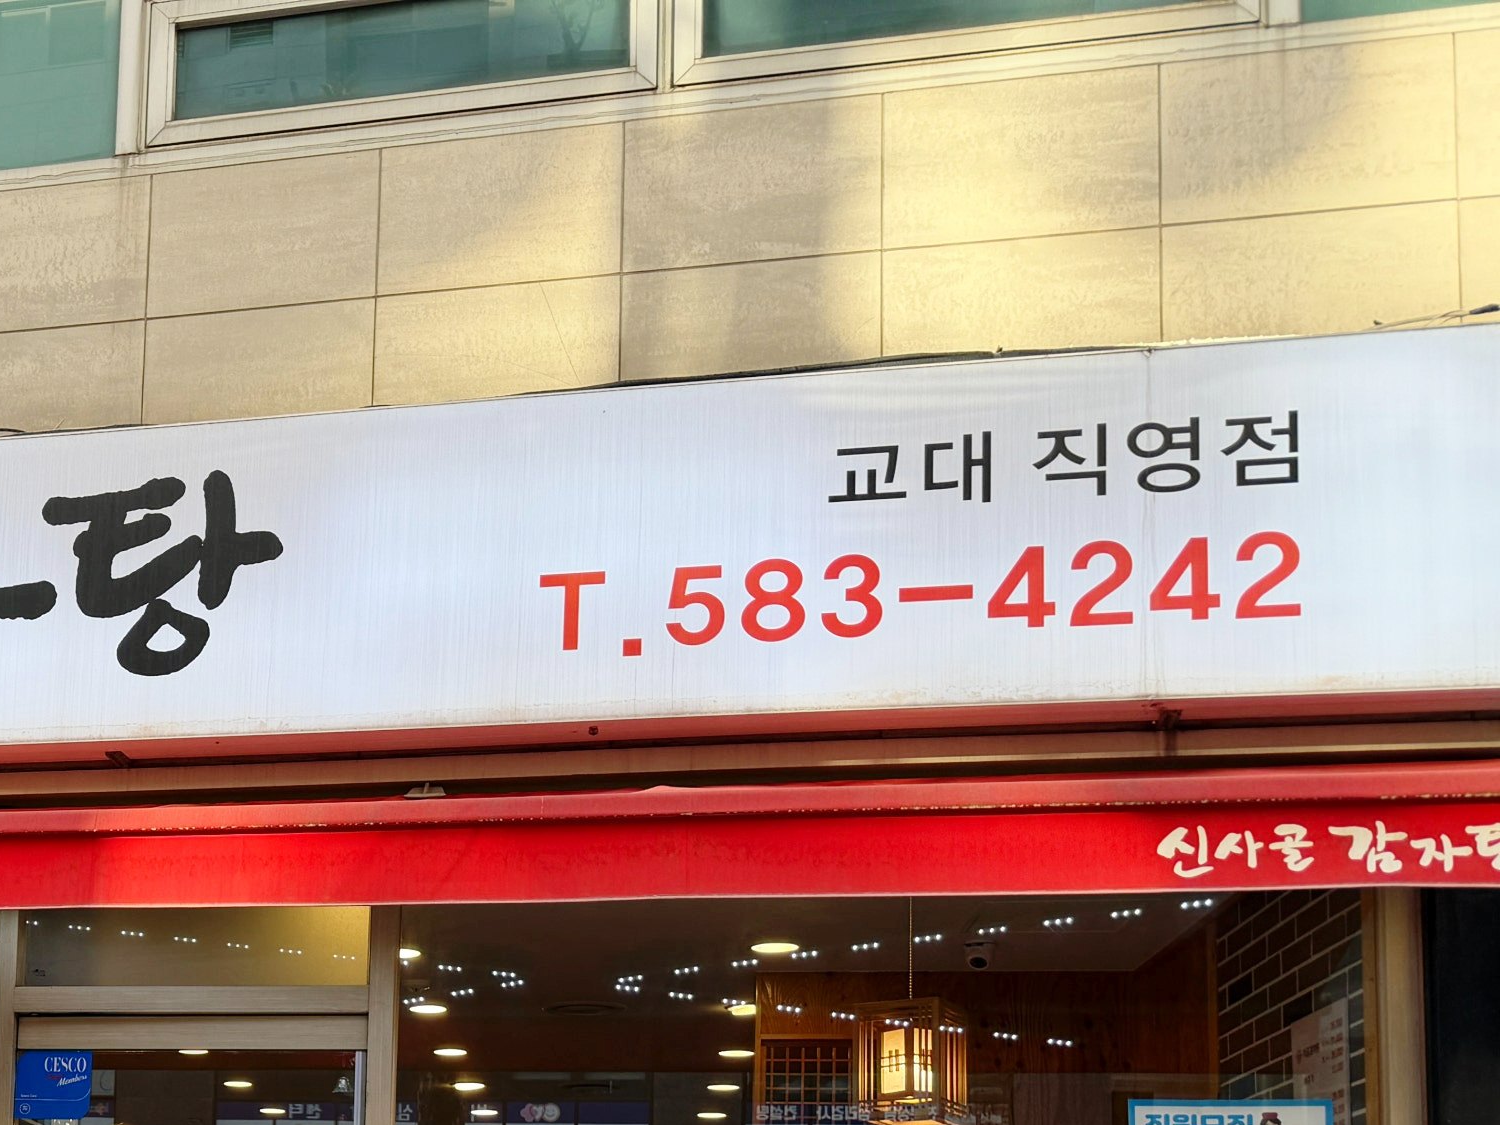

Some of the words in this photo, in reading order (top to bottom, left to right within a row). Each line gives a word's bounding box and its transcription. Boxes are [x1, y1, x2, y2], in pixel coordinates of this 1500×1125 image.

[828, 431, 993, 503] 교대
[1031, 409, 1300, 496] 직영점
[1156, 823, 1314, 878] 신사골
[44, 1057, 87, 1072] CESCO
[56, 1073, 88, 1087] Members
